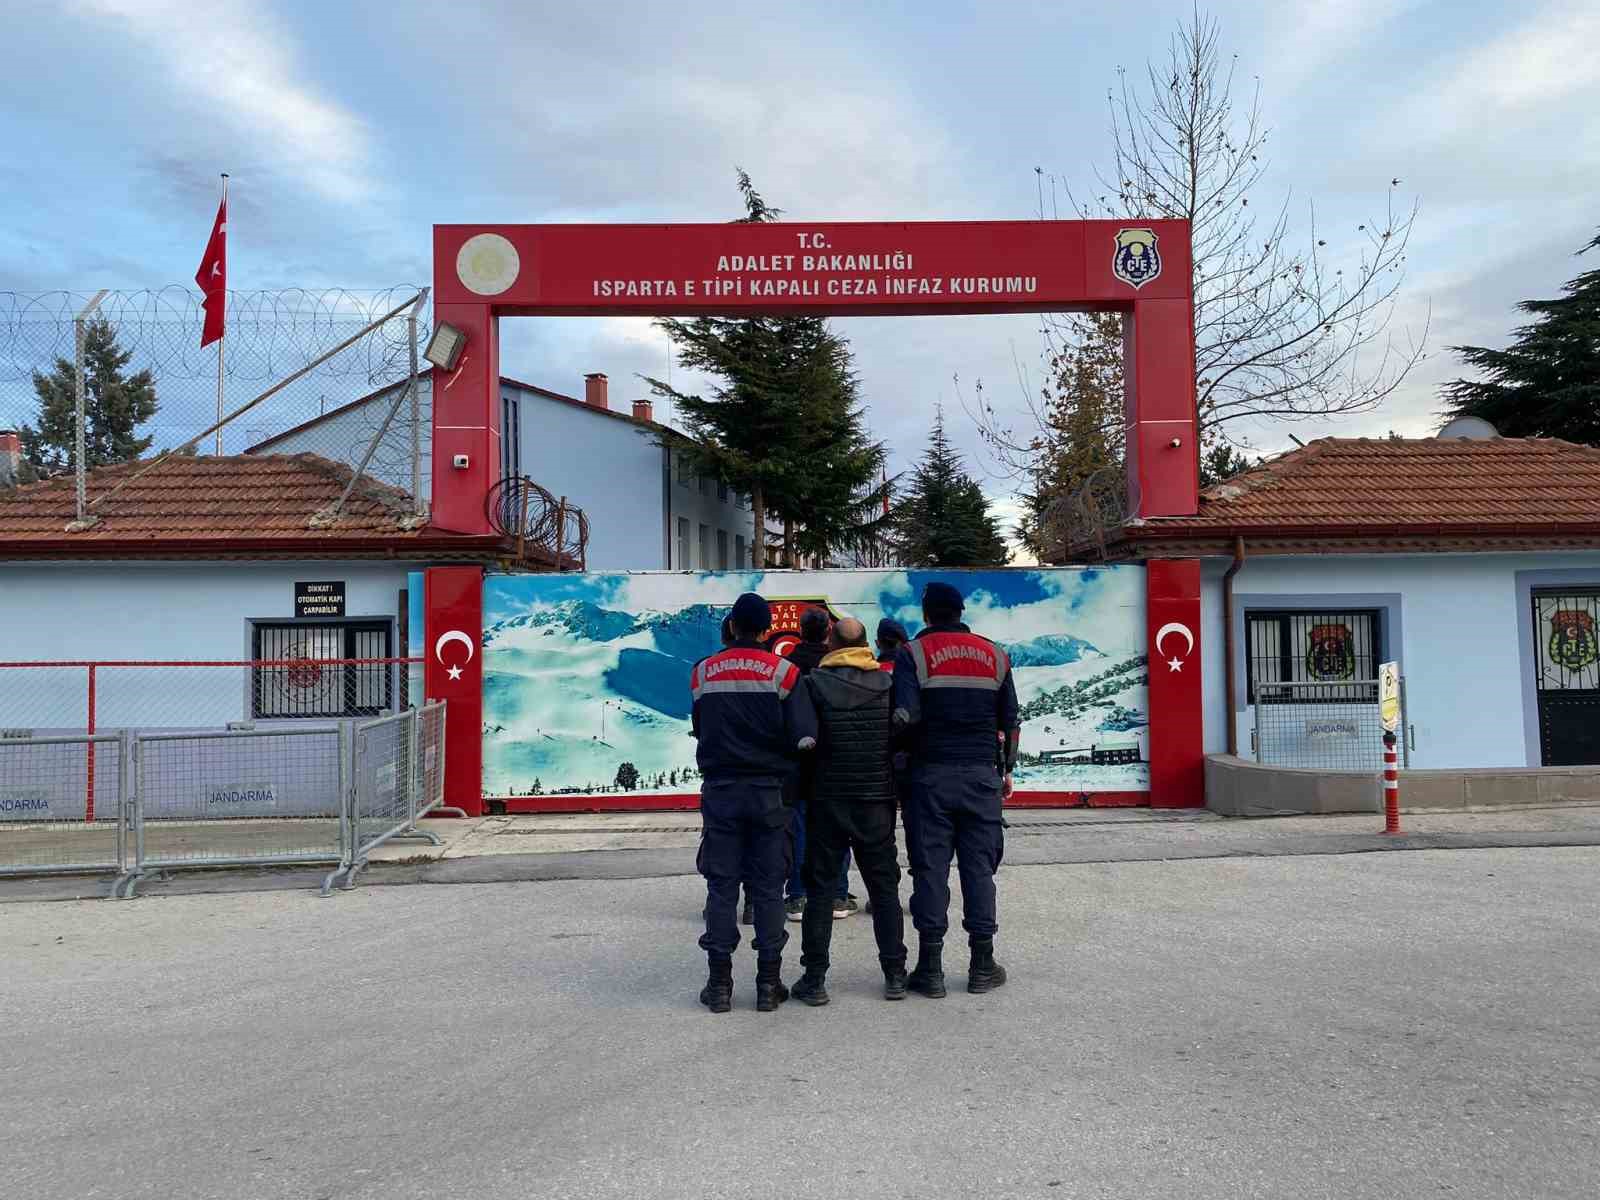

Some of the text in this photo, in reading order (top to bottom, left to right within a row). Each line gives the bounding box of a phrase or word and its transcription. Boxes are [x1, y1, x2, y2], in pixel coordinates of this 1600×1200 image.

[797, 233, 832, 249] T.C.
[717, 250, 913, 272] ADALET BAKANLIĞI
[593, 275, 1037, 297] ISPARTA E TİPİ KAPALI CEZA İNFAZ KURUMU
[928, 645, 994, 669] JANDARMA
[706, 658, 775, 678] JANDARMA
[208, 789, 274, 803] JANDARMA
